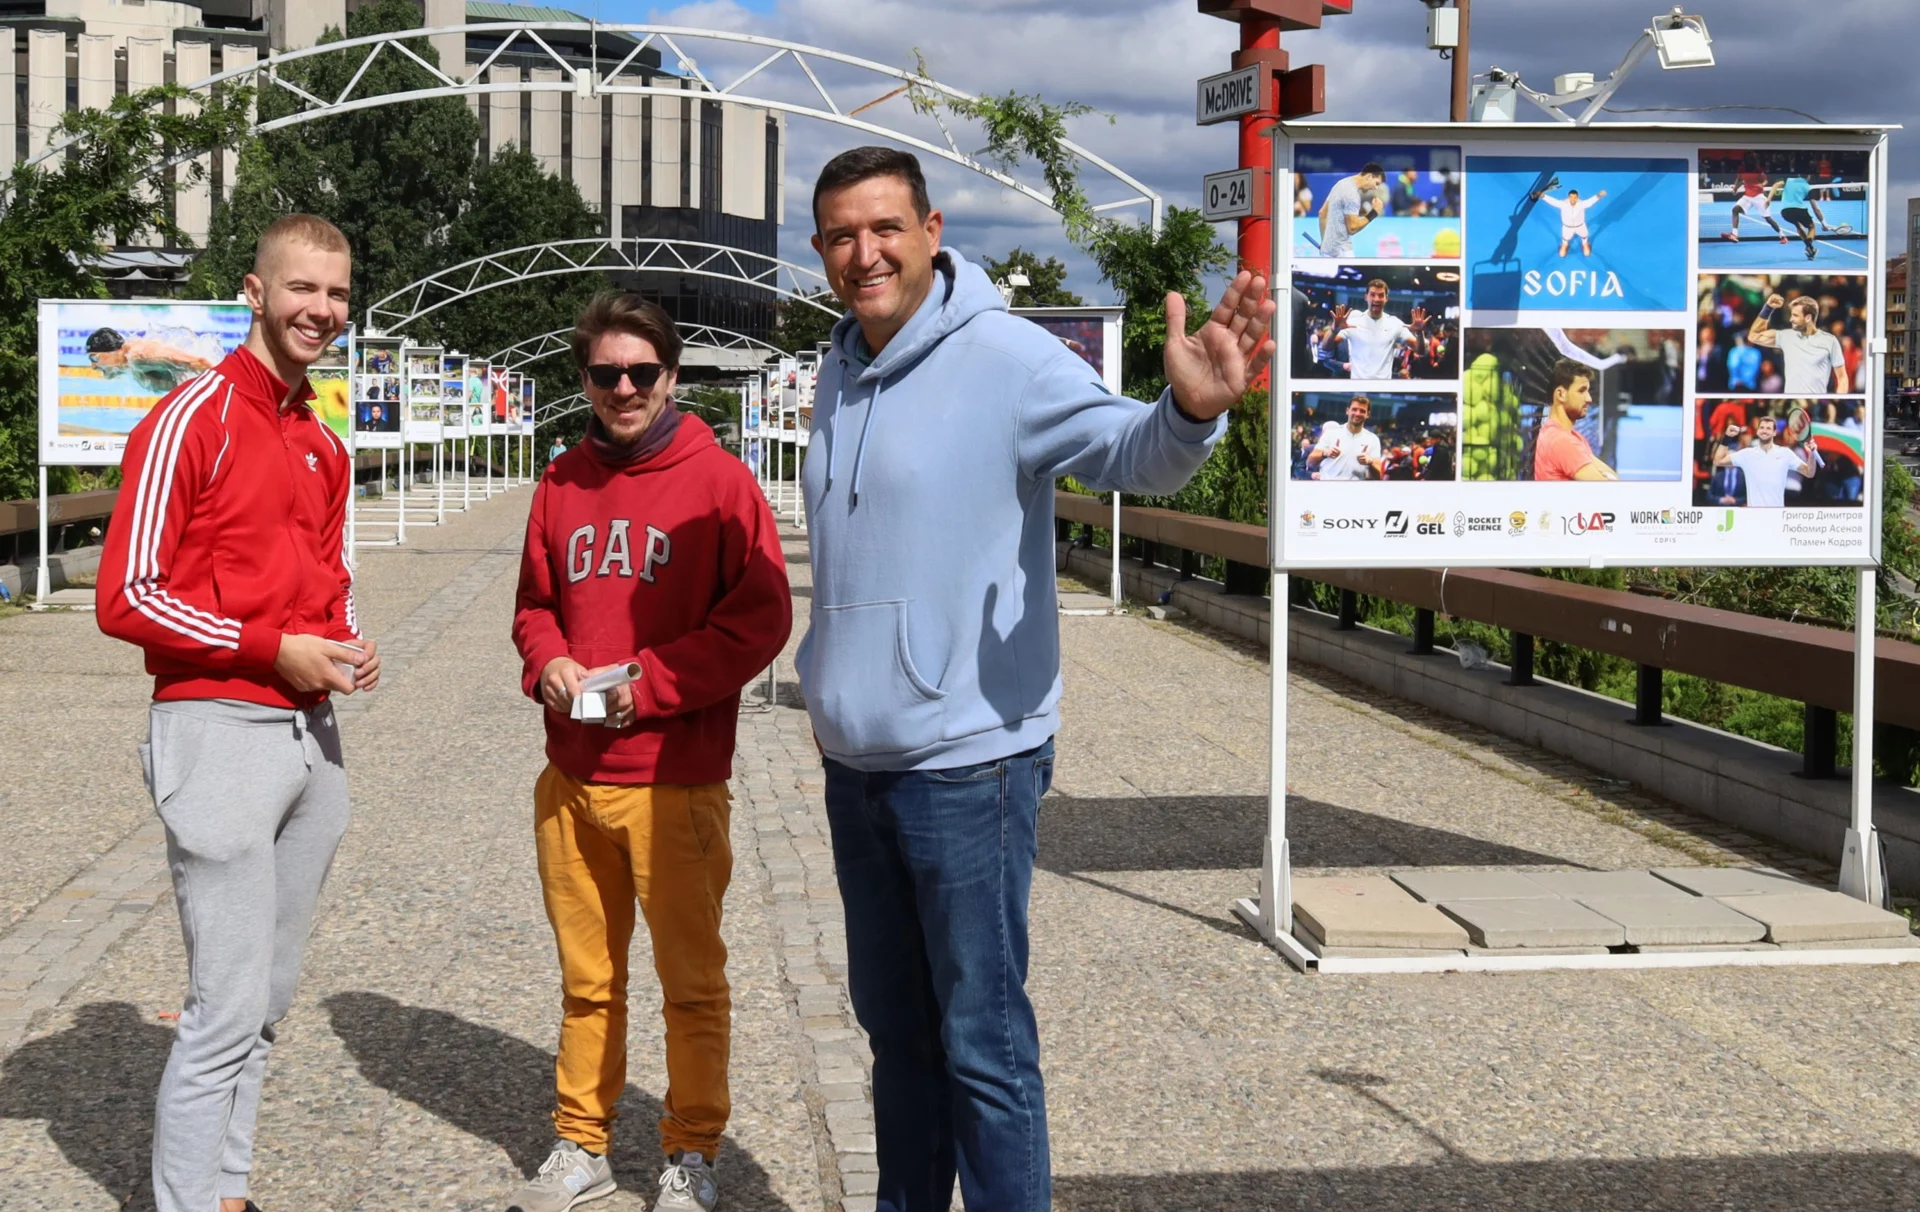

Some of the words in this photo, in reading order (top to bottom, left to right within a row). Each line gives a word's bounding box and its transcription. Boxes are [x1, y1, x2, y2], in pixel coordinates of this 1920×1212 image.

[1205, 75, 1253, 115] McDRIVE
[1523, 269, 1624, 297] SOFIA
[1630, 511, 1660, 524] WORK
[1676, 511, 1703, 524] SHOP
[1782, 510, 1815, 520] Григор
[1816, 510, 1863, 520] Димитров
[1323, 518, 1378, 529] SONY
[1416, 523, 1445, 535] GEL
[1782, 524, 1827, 534] Любомир
[1829, 524, 1863, 533] Асенов
[1790, 537, 1826, 546] Пламен
[1827, 537, 1863, 547] Кодров
[566, 518, 672, 584] GAP
